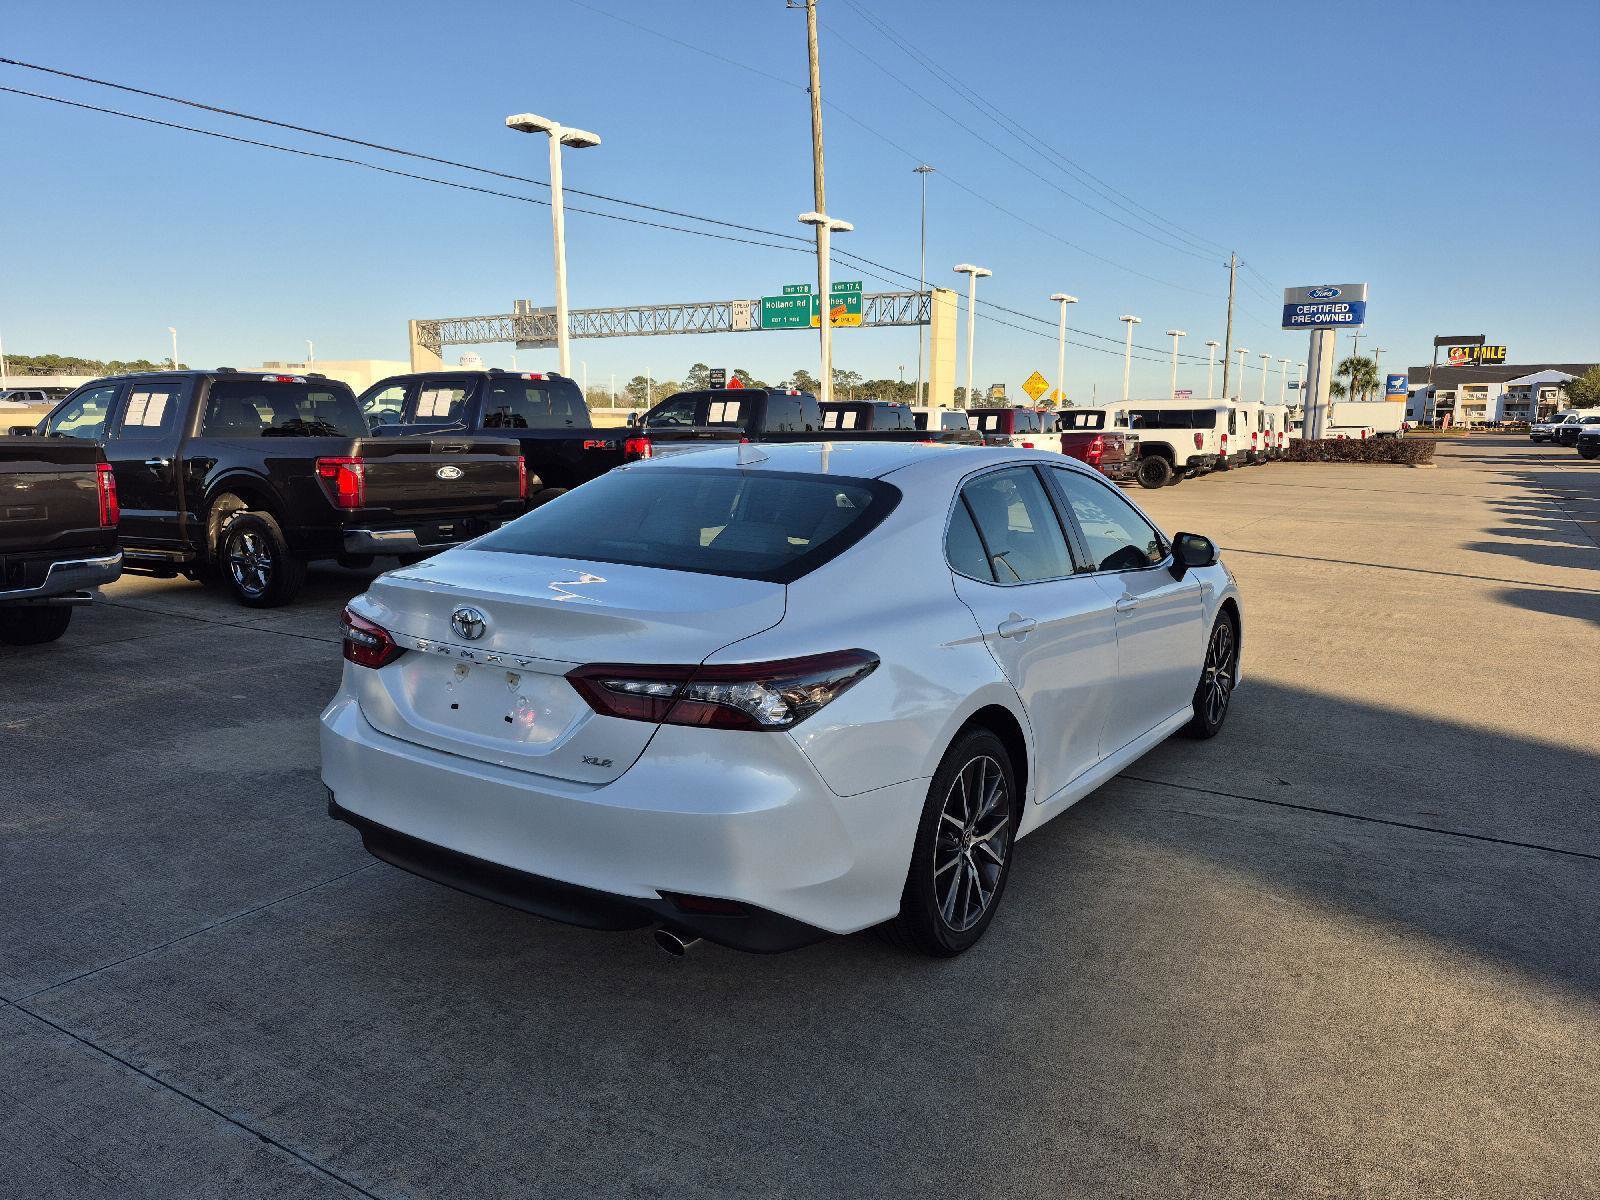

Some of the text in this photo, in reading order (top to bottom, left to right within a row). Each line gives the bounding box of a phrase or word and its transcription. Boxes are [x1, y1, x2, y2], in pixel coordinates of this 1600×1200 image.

[766, 299, 806, 309] Holland Rd
[847, 296, 857, 305] Rd
[1296, 303, 1350, 314] CERTIFIED
[1291, 313, 1353, 323] PRE-OWNED
[1463, 346, 1506, 359] 1 MILE
[583, 439, 616, 450] FX4
[416, 639, 533, 667] CAMRY
[581, 755, 613, 768] XLE
